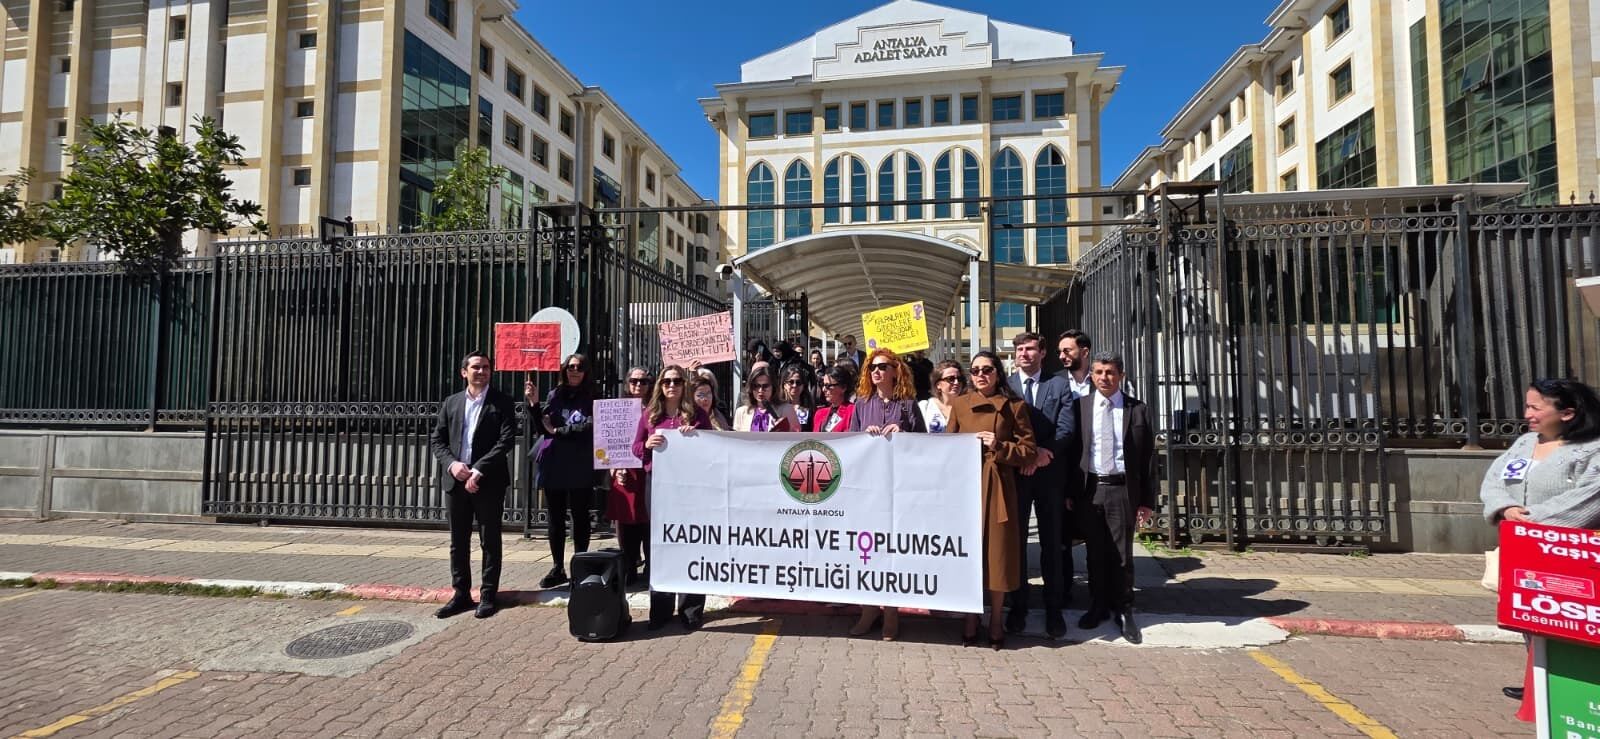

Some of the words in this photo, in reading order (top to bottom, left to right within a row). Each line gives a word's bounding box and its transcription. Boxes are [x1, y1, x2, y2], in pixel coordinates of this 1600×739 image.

[873, 36, 927, 50] ANTALYA
[854, 49, 900, 63] ADALET
[903, 45, 947, 59] SARAYI
[776, 508, 811, 516] ANTALYA
[812, 509, 845, 517] BAROSU
[663, 523, 722, 545] KADIN
[728, 525, 809, 550] HAKLARI
[815, 529, 840, 551] VE
[846, 530, 969, 562] TOPLUMSAL
[687, 556, 770, 585] CİNSİYET
[776, 561, 850, 592] EŞİTLİĞİ
[857, 570, 938, 596] KURULU
[1512, 610, 1579, 631] Lösemili
